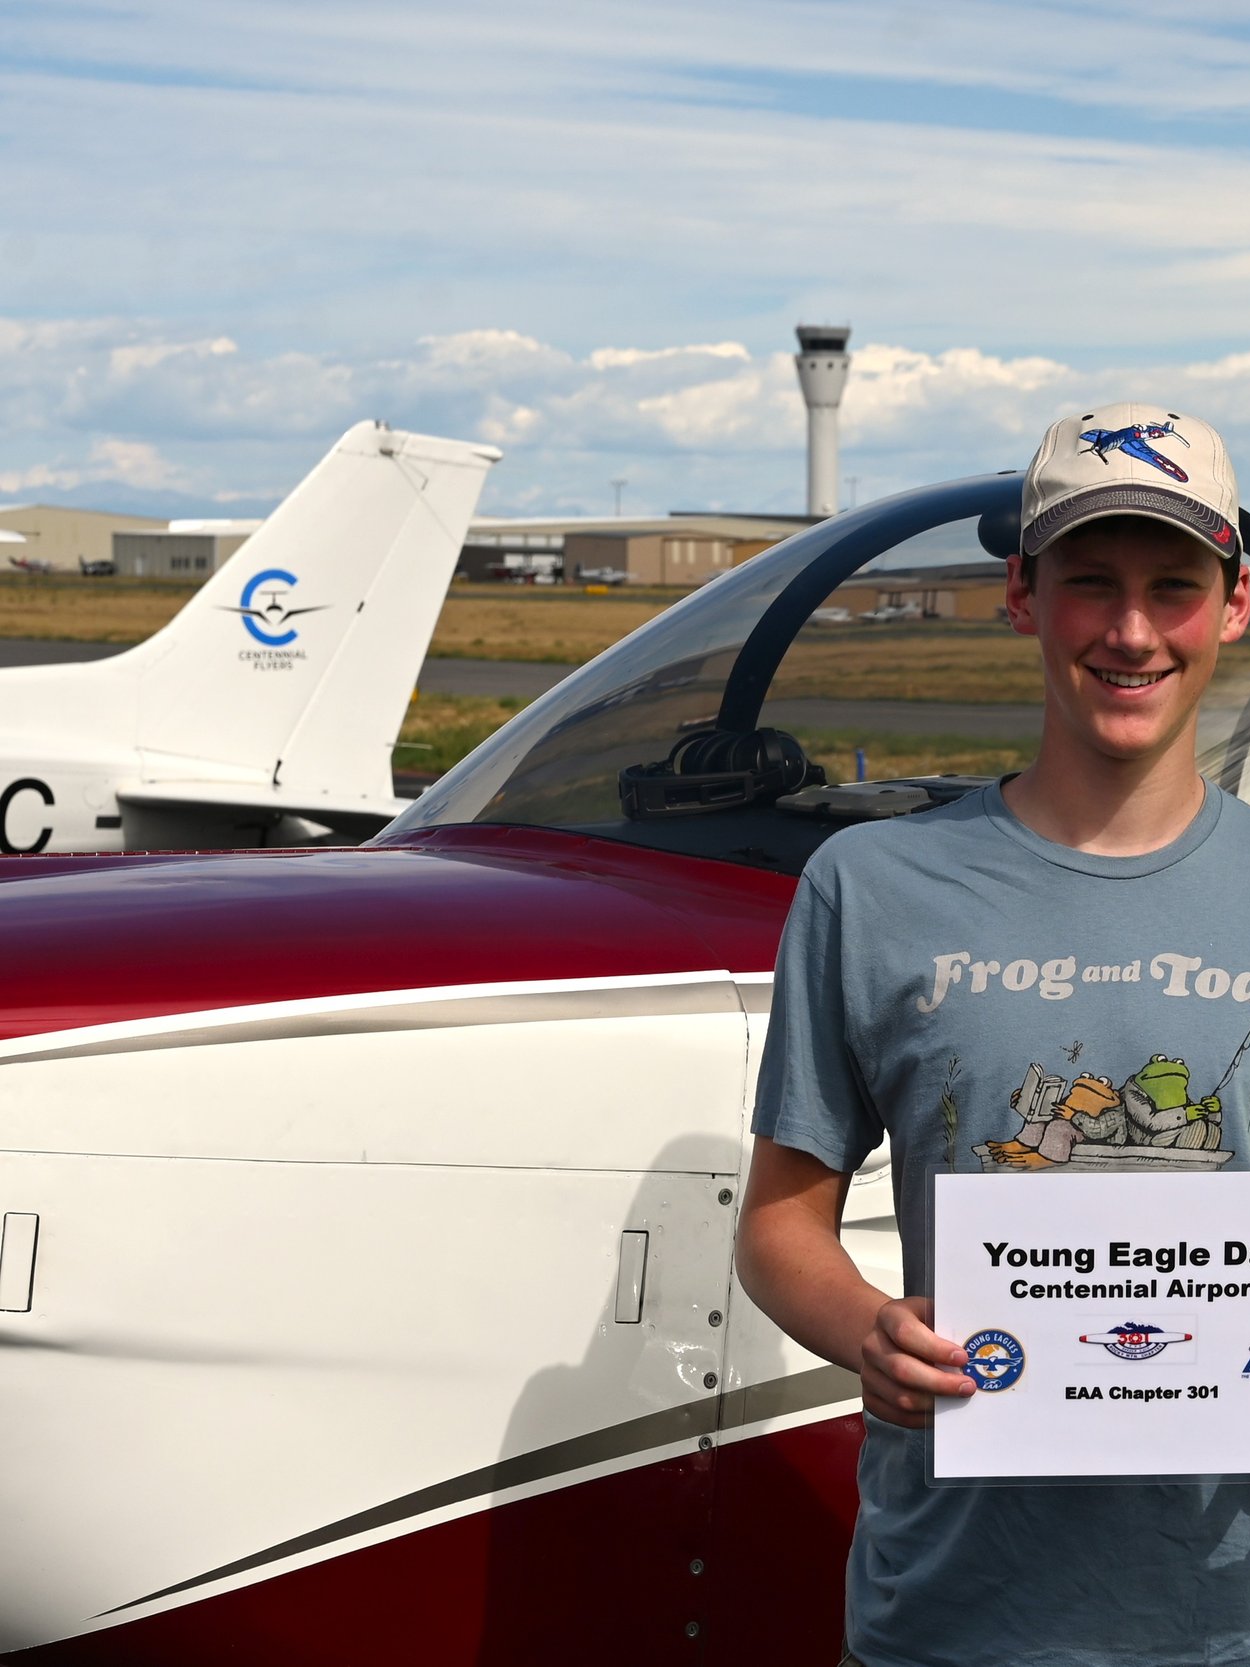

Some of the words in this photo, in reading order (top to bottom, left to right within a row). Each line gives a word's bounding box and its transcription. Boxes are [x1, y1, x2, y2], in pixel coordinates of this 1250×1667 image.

[239, 650, 307, 661] CENTENNIAL
[254, 660, 293, 671] FLYERS
[917, 951, 1077, 1014] Frog
[1081, 960, 1142, 983] and
[982, 1242, 1095, 1273] Young
[1109, 1242, 1211, 1273] Eagle
[1010, 1279, 1157, 1299] Centennial
[966, 1334, 991, 1354] YOUNG
[994, 1333, 1018, 1354] EAGLES
[1117, 1332, 1149, 1345] 301
[1065, 1386, 1103, 1399] EAA
[1109, 1387, 1182, 1402] Chapter
[1187, 1385, 1218, 1399] 301
